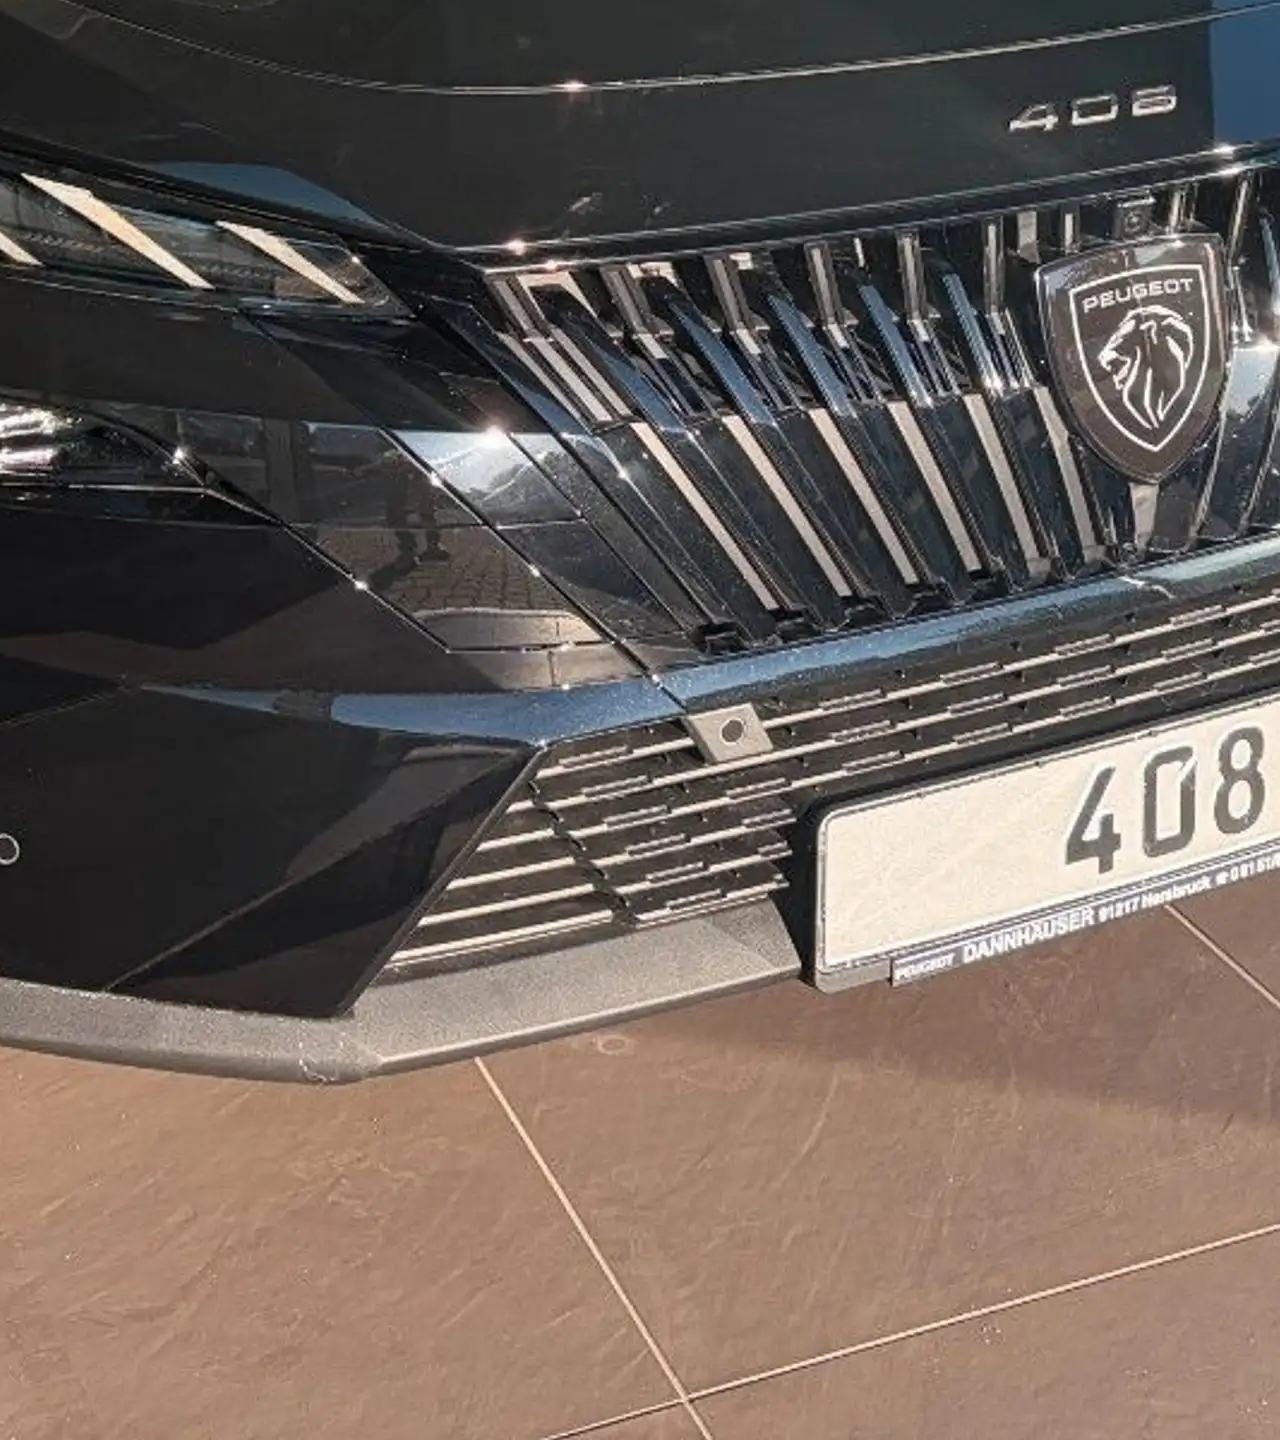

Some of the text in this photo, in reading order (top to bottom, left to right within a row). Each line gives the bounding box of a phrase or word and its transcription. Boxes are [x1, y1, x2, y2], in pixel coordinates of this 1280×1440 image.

[1008, 85, 1178, 132] 408
[1081, 277, 1194, 314] PEUGEOT
[1064, 725, 1266, 874] 408
